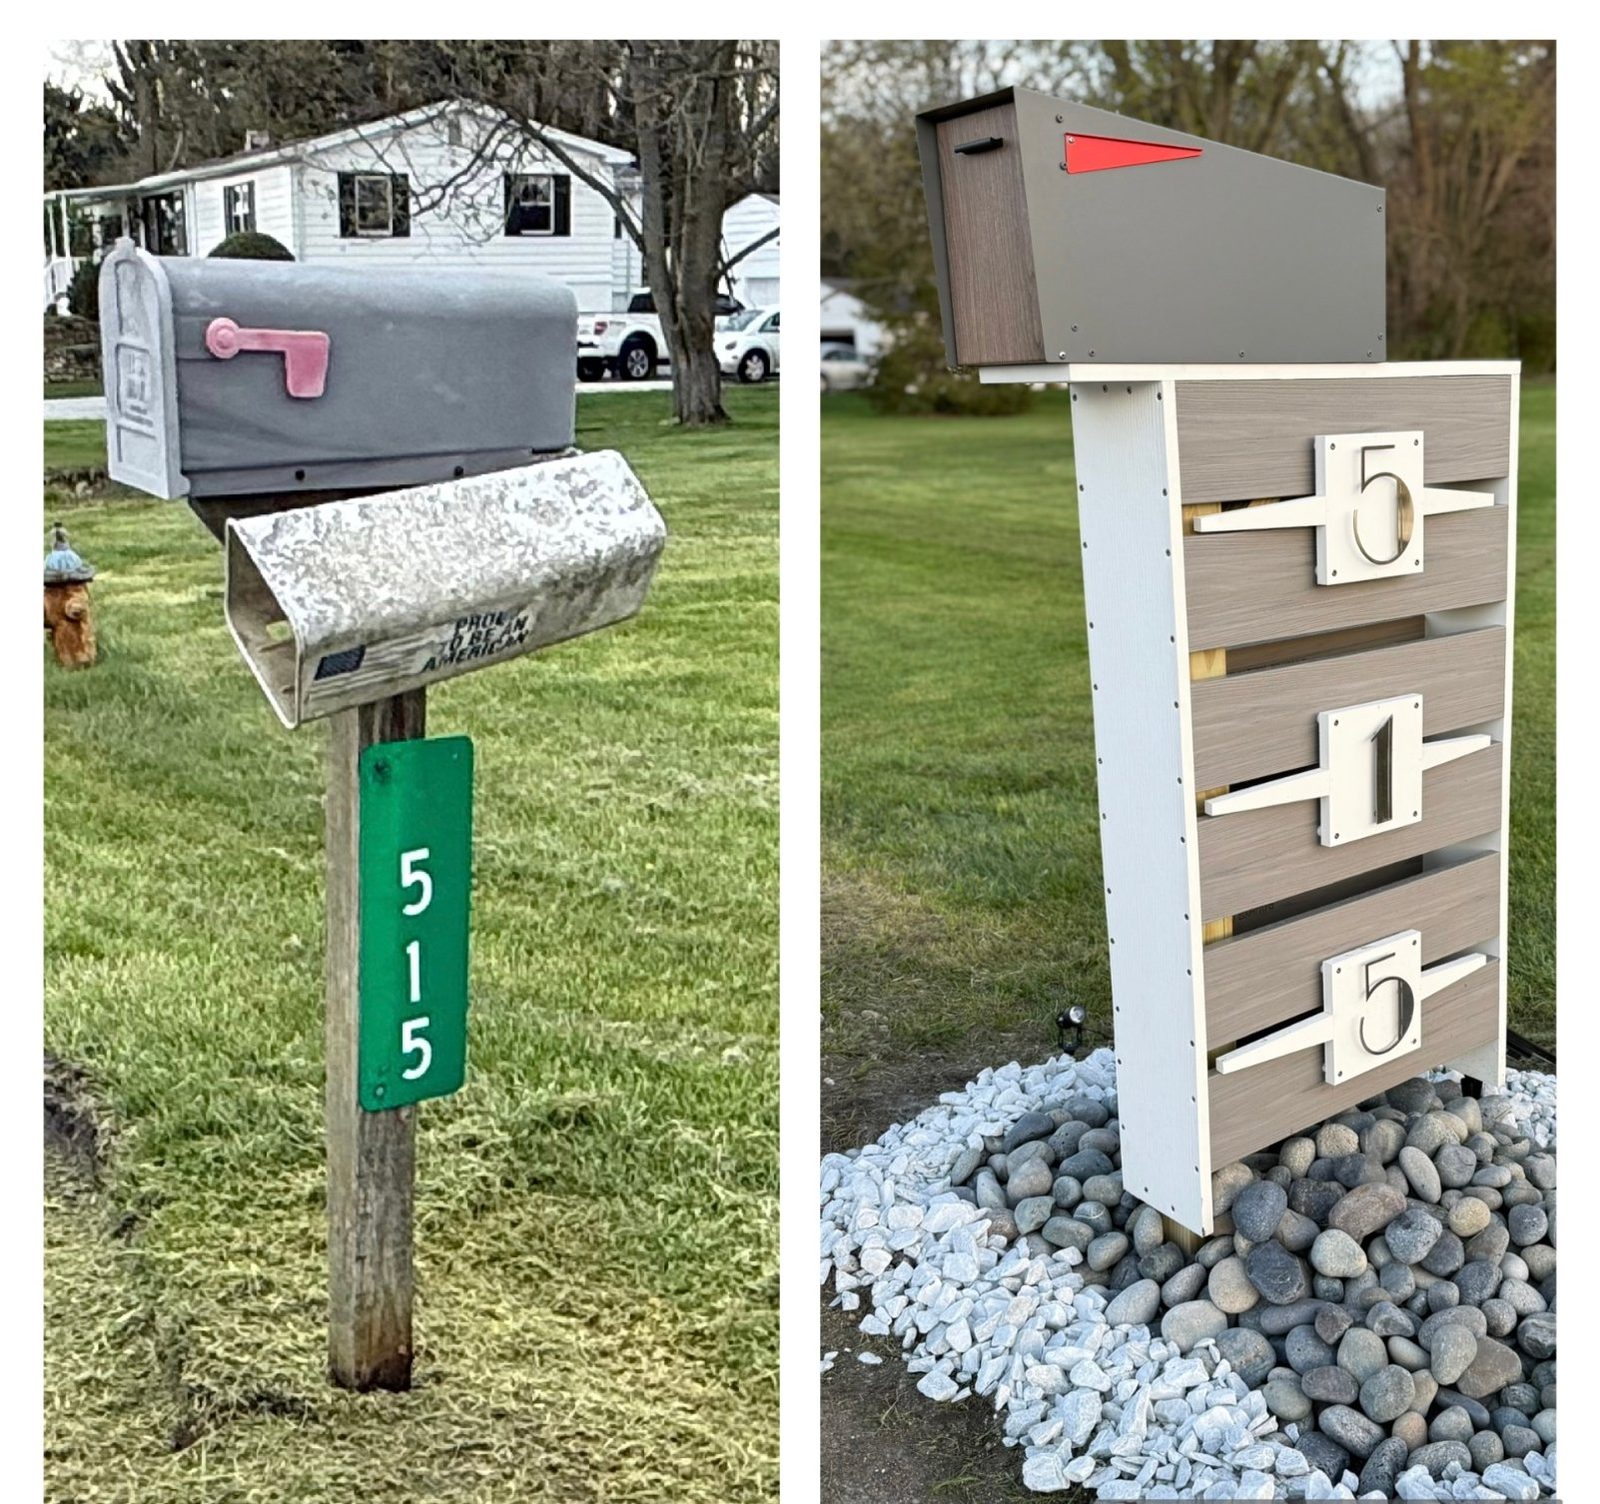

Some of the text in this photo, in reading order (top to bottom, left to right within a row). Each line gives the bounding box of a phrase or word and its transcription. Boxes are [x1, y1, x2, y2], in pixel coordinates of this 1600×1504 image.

[1353, 444, 1414, 565] 5
[468, 627, 496, 645] BE
[499, 615, 529, 641] AN
[1371, 714, 1393, 824] 1
[1360, 952, 1414, 1055] 5
